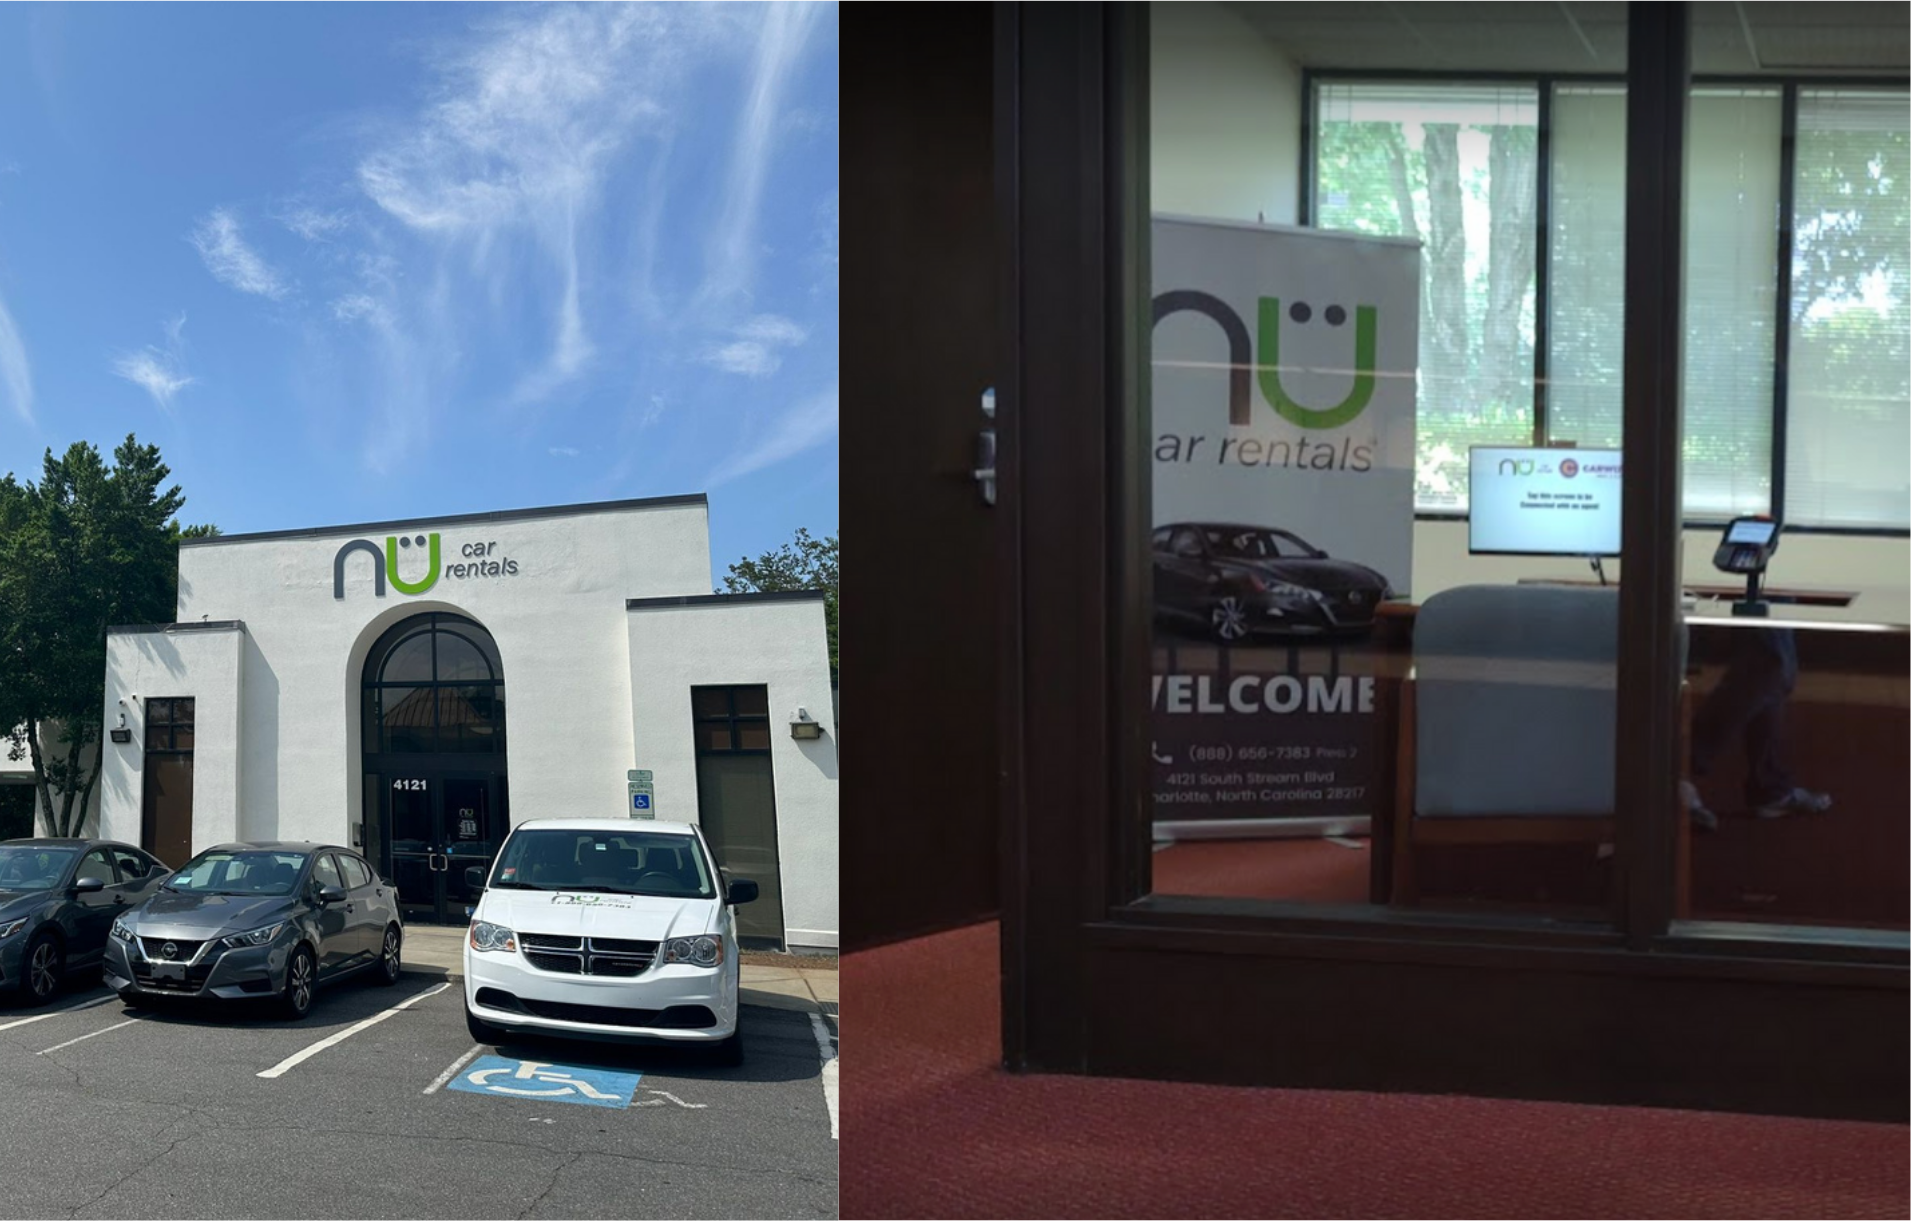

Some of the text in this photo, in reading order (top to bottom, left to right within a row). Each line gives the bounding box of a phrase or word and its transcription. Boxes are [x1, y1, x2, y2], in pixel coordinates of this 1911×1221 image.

[1154, 433, 1373, 473] ar rentals
[461, 541, 497, 558] car
[445, 557, 519, 579] rentals
[1152, 674, 1375, 714] ELCOME
[1189, 745, 1234, 762] (888)
[1238, 746, 1311, 761] 656-7383
[393, 779, 427, 791] 4121
[1166, 770, 1335, 785] 4121 South Stream Blvd
[1153, 790, 1213, 804] arlotte,
[1216, 788, 1257, 802] North
[1260, 787, 1323, 801] Carolina
